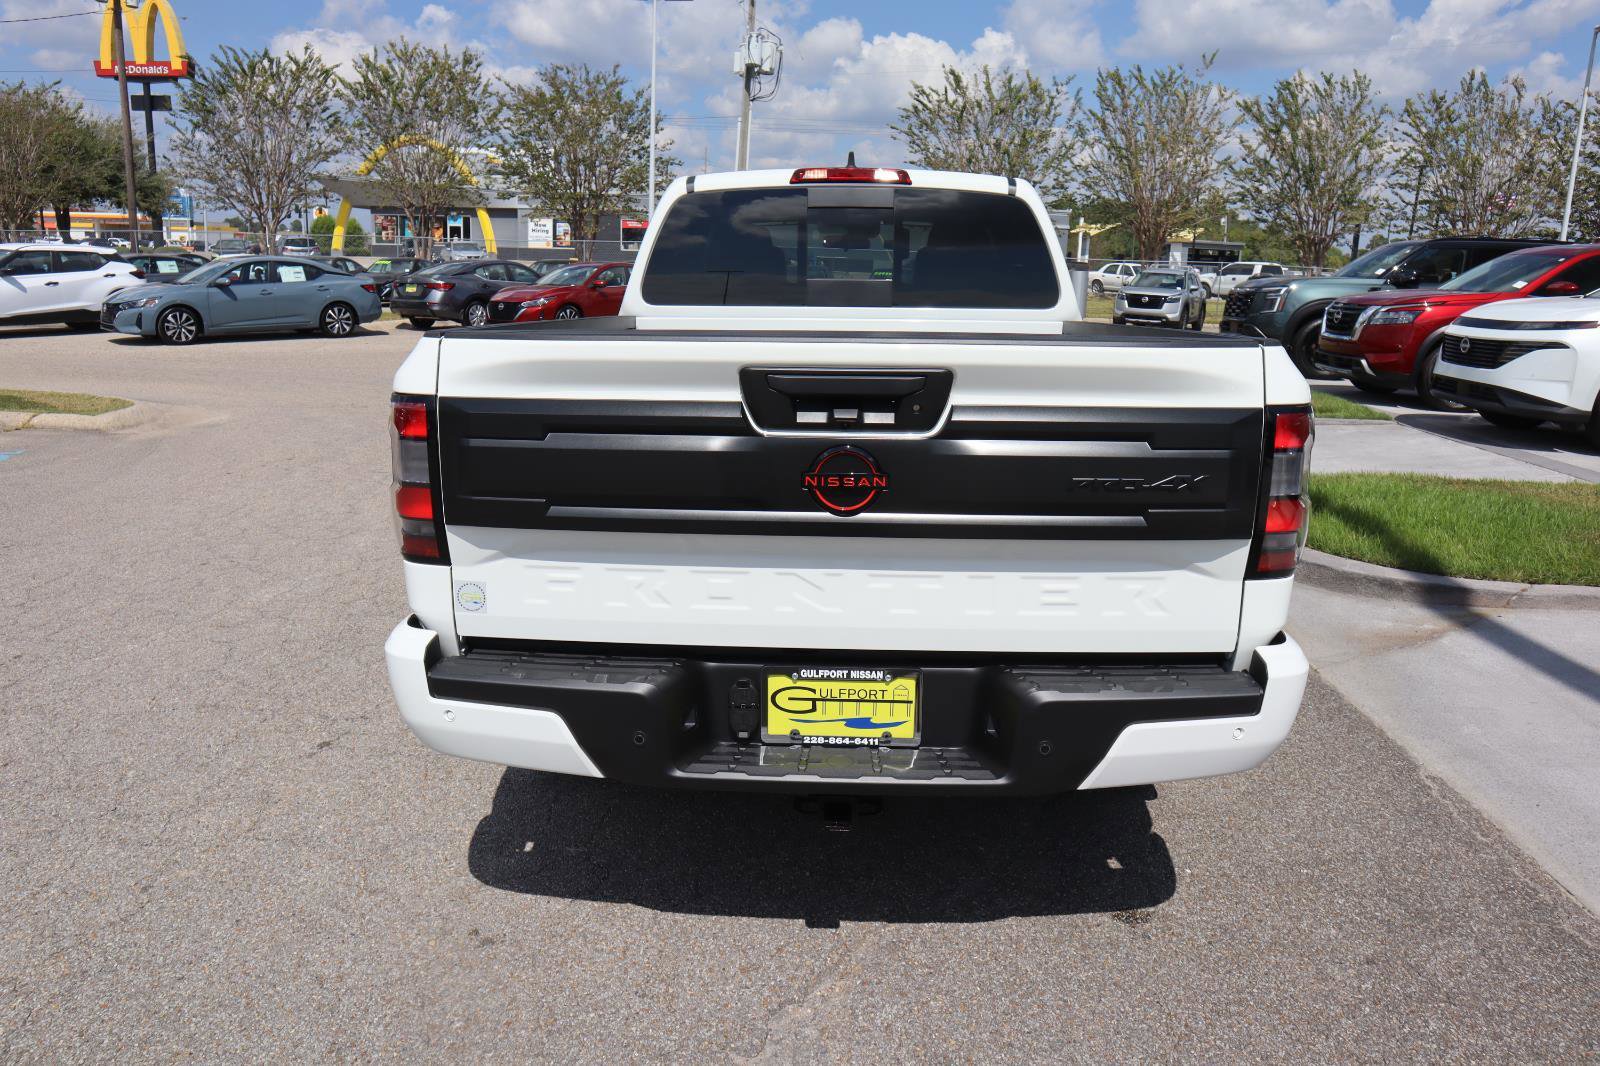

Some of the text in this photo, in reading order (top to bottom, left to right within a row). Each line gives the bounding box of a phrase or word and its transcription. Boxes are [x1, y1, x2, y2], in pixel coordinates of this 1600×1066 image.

[804, 475, 887, 488] NISSAN
[800, 669, 884, 680] GULFPORT NISSAN
[803, 736, 879, 746] 228-864-6411
